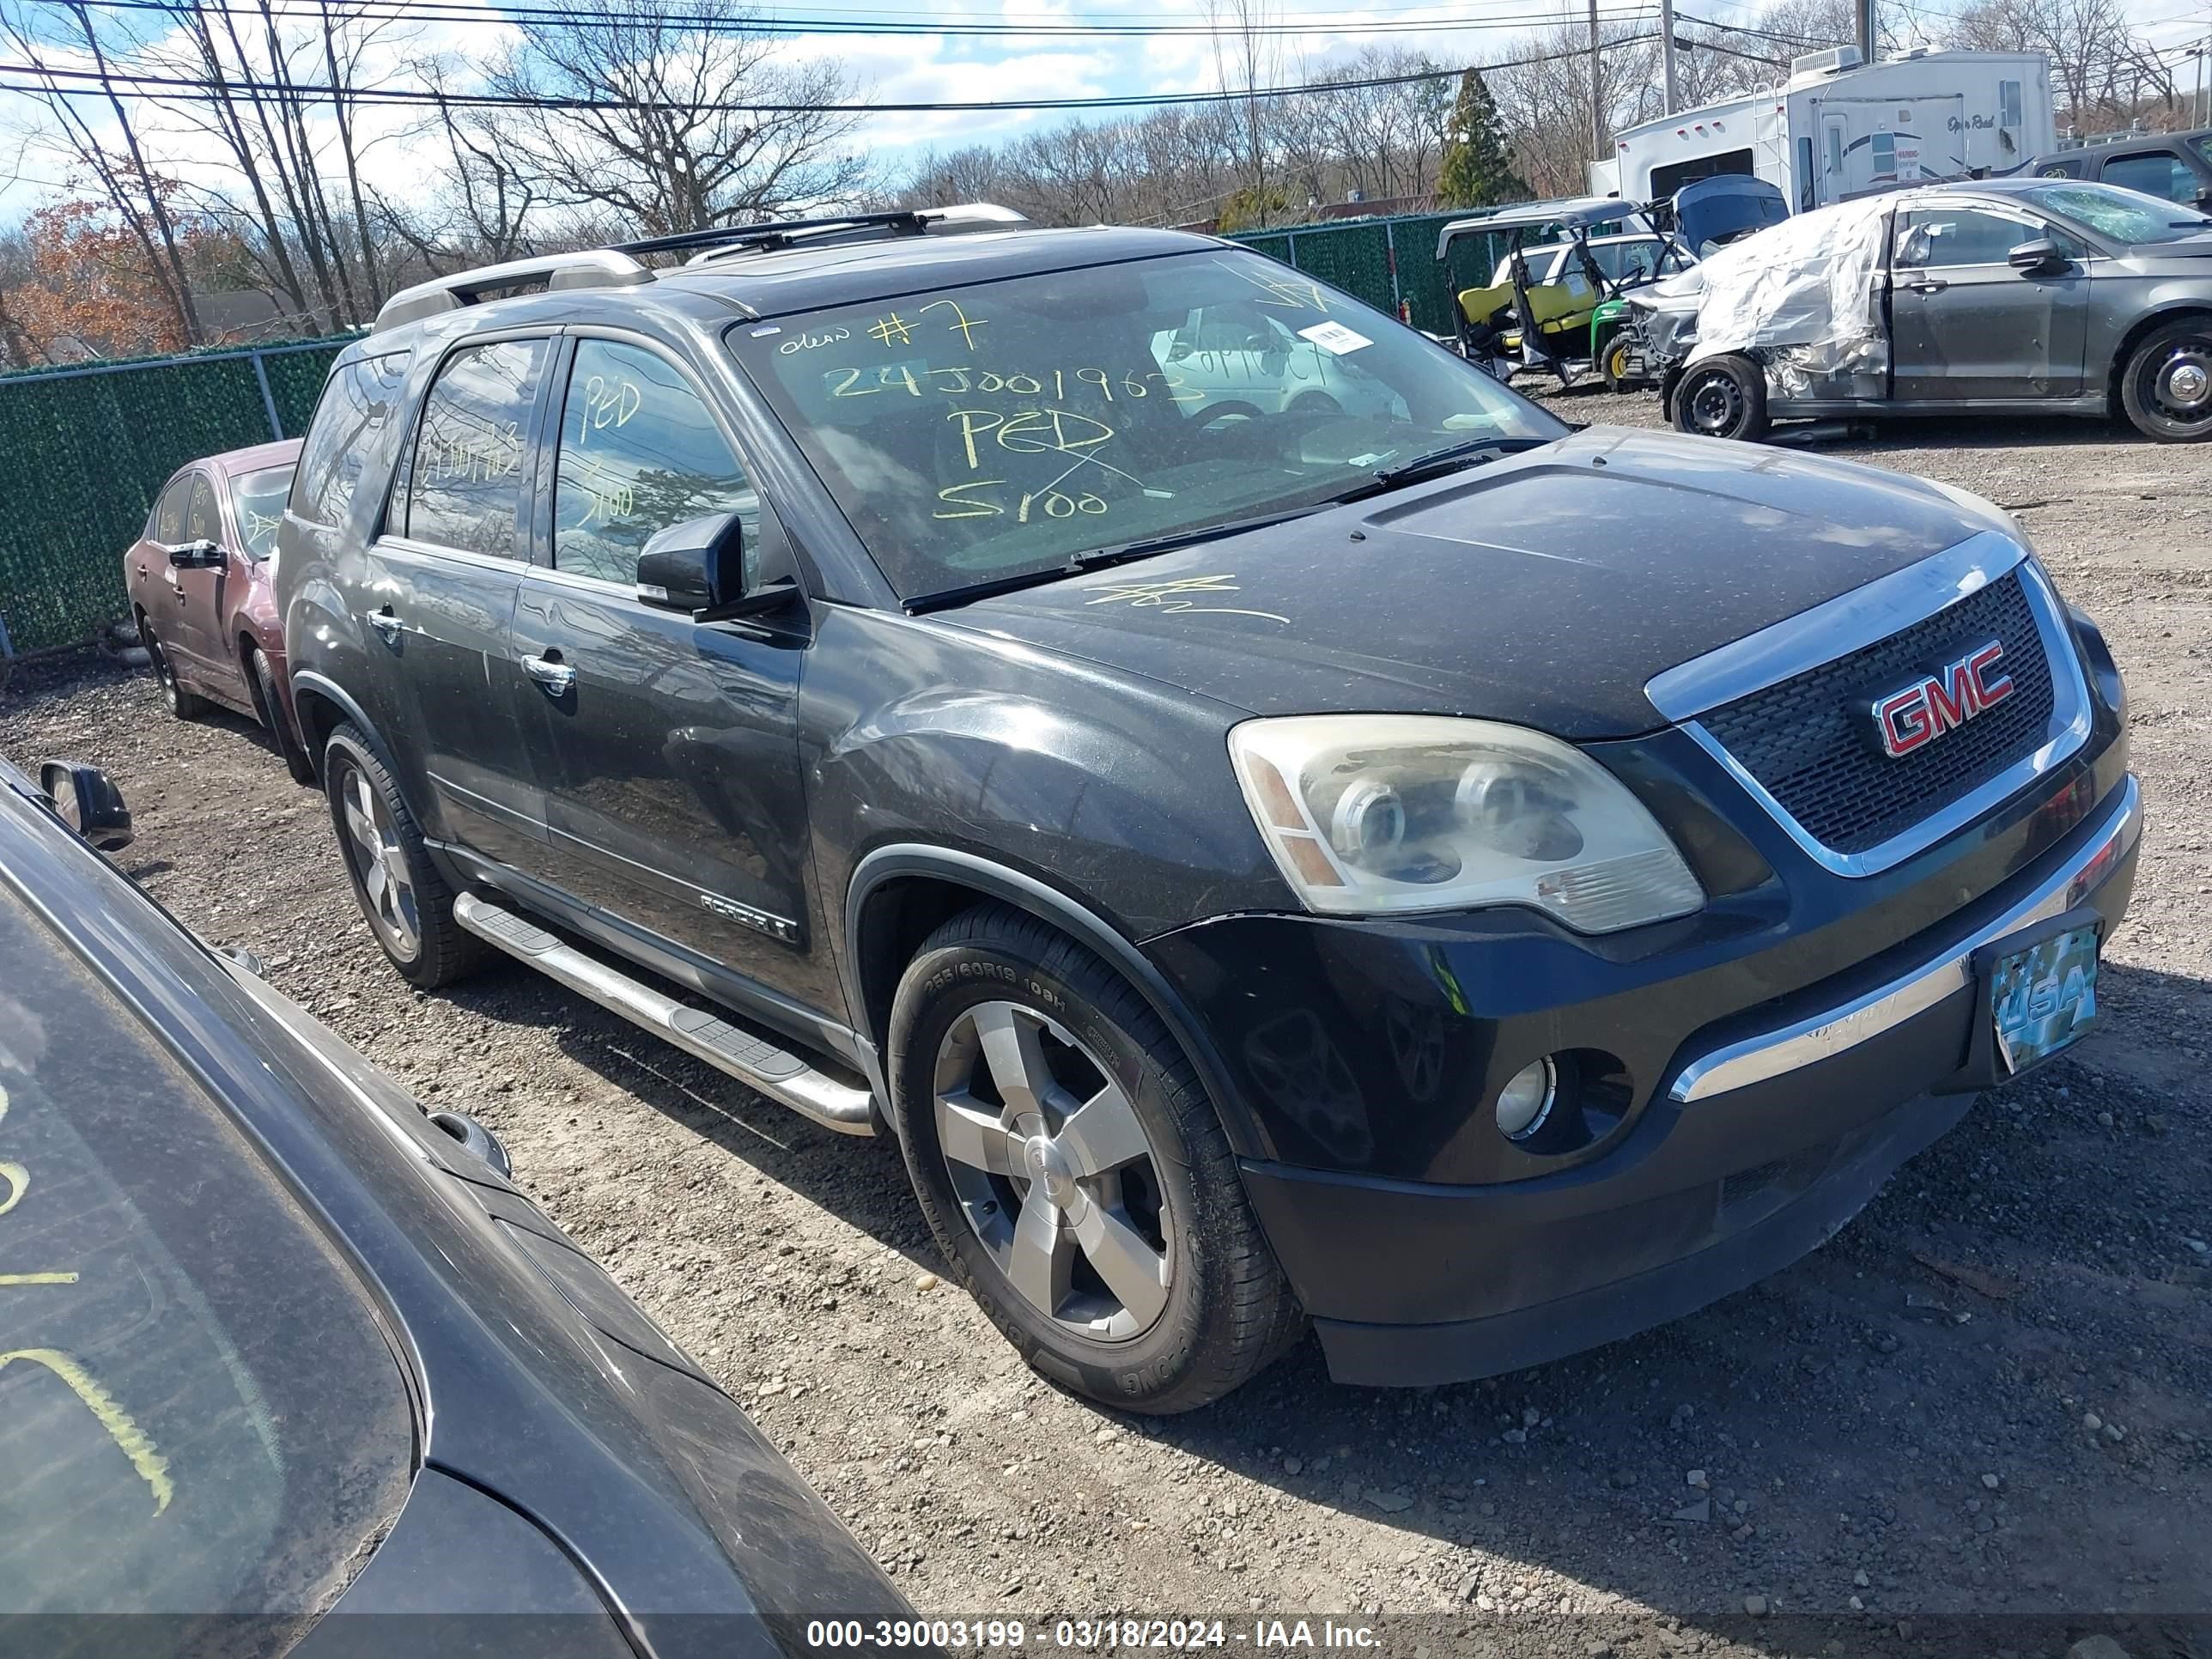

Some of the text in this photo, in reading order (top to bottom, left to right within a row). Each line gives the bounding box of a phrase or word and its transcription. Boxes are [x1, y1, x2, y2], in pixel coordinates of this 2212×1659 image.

[946, 409, 1115, 469] PED
[1871, 639, 2015, 758] GMC
[1997, 964, 2087, 1038] USA
